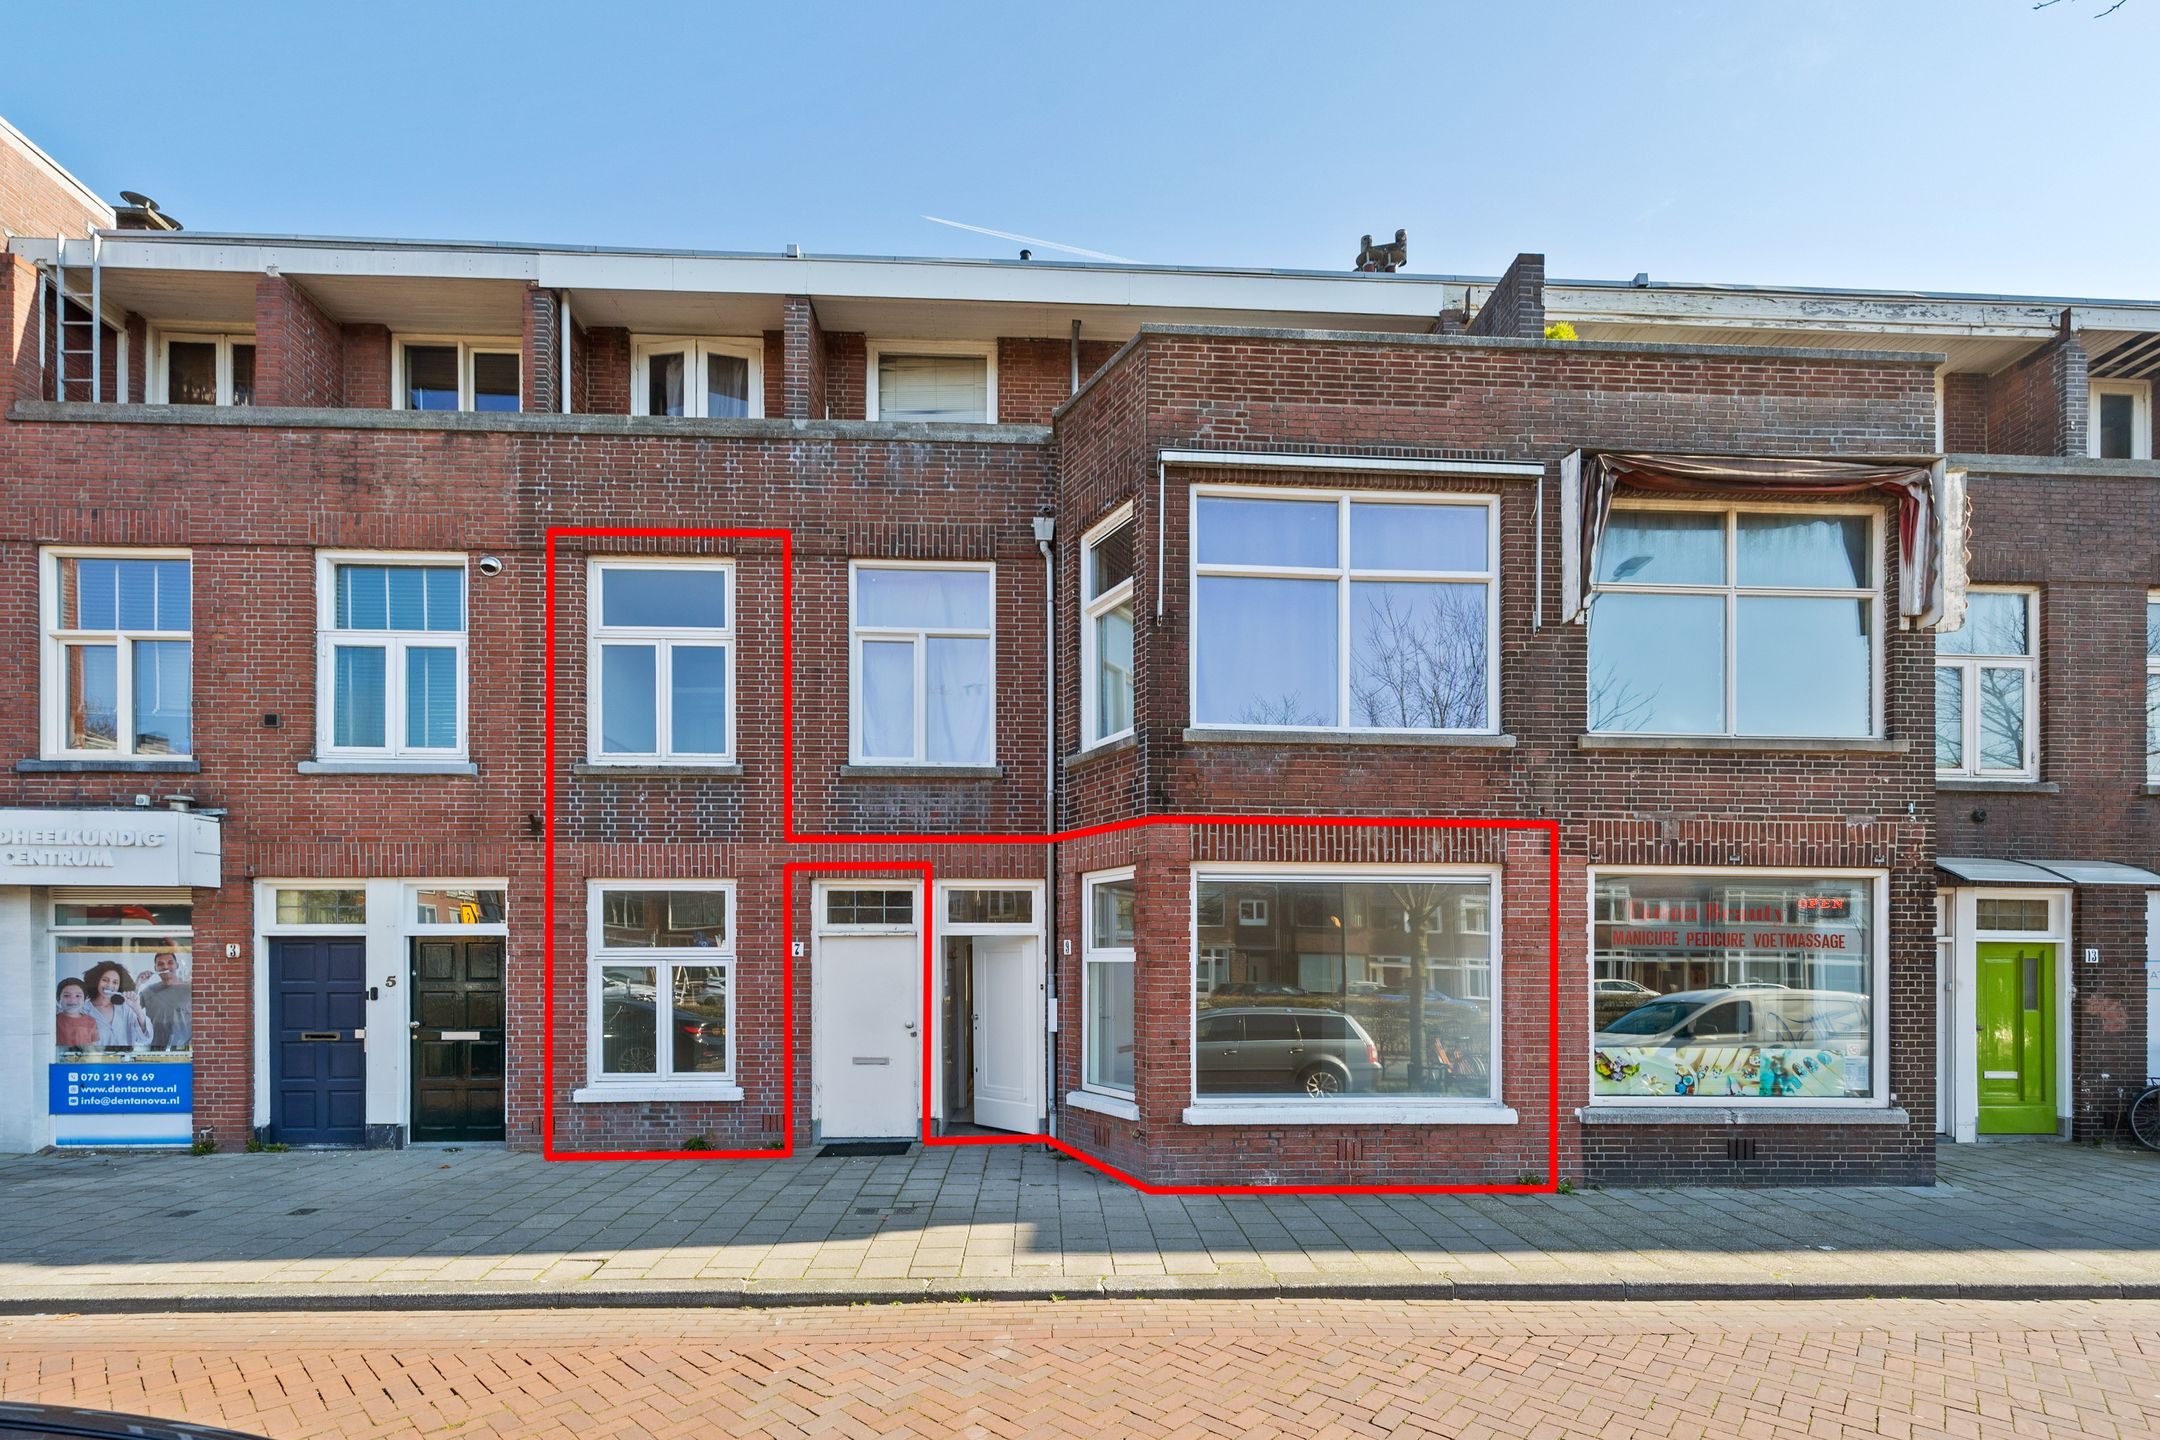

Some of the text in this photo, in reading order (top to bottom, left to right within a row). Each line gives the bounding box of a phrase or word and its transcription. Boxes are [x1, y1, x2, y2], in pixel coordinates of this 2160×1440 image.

[1, 850, 115, 868] CENTRUM
[1796, 897, 1844, 909] OPEN
[1705, 900, 1784, 928] Beauty
[1612, 929, 1846, 949] MANICURE PEDICURE VOETMASSAGE
[794, 943, 801, 955] 7
[2087, 950, 2097, 962] 13
[385, 975, 397, 988] 5
[80, 1073, 155, 1081] 070 219 96 69
[80, 1084, 177, 1093] www.dentanova.nl
[80, 1096, 180, 1106] info@dentanova.nl
